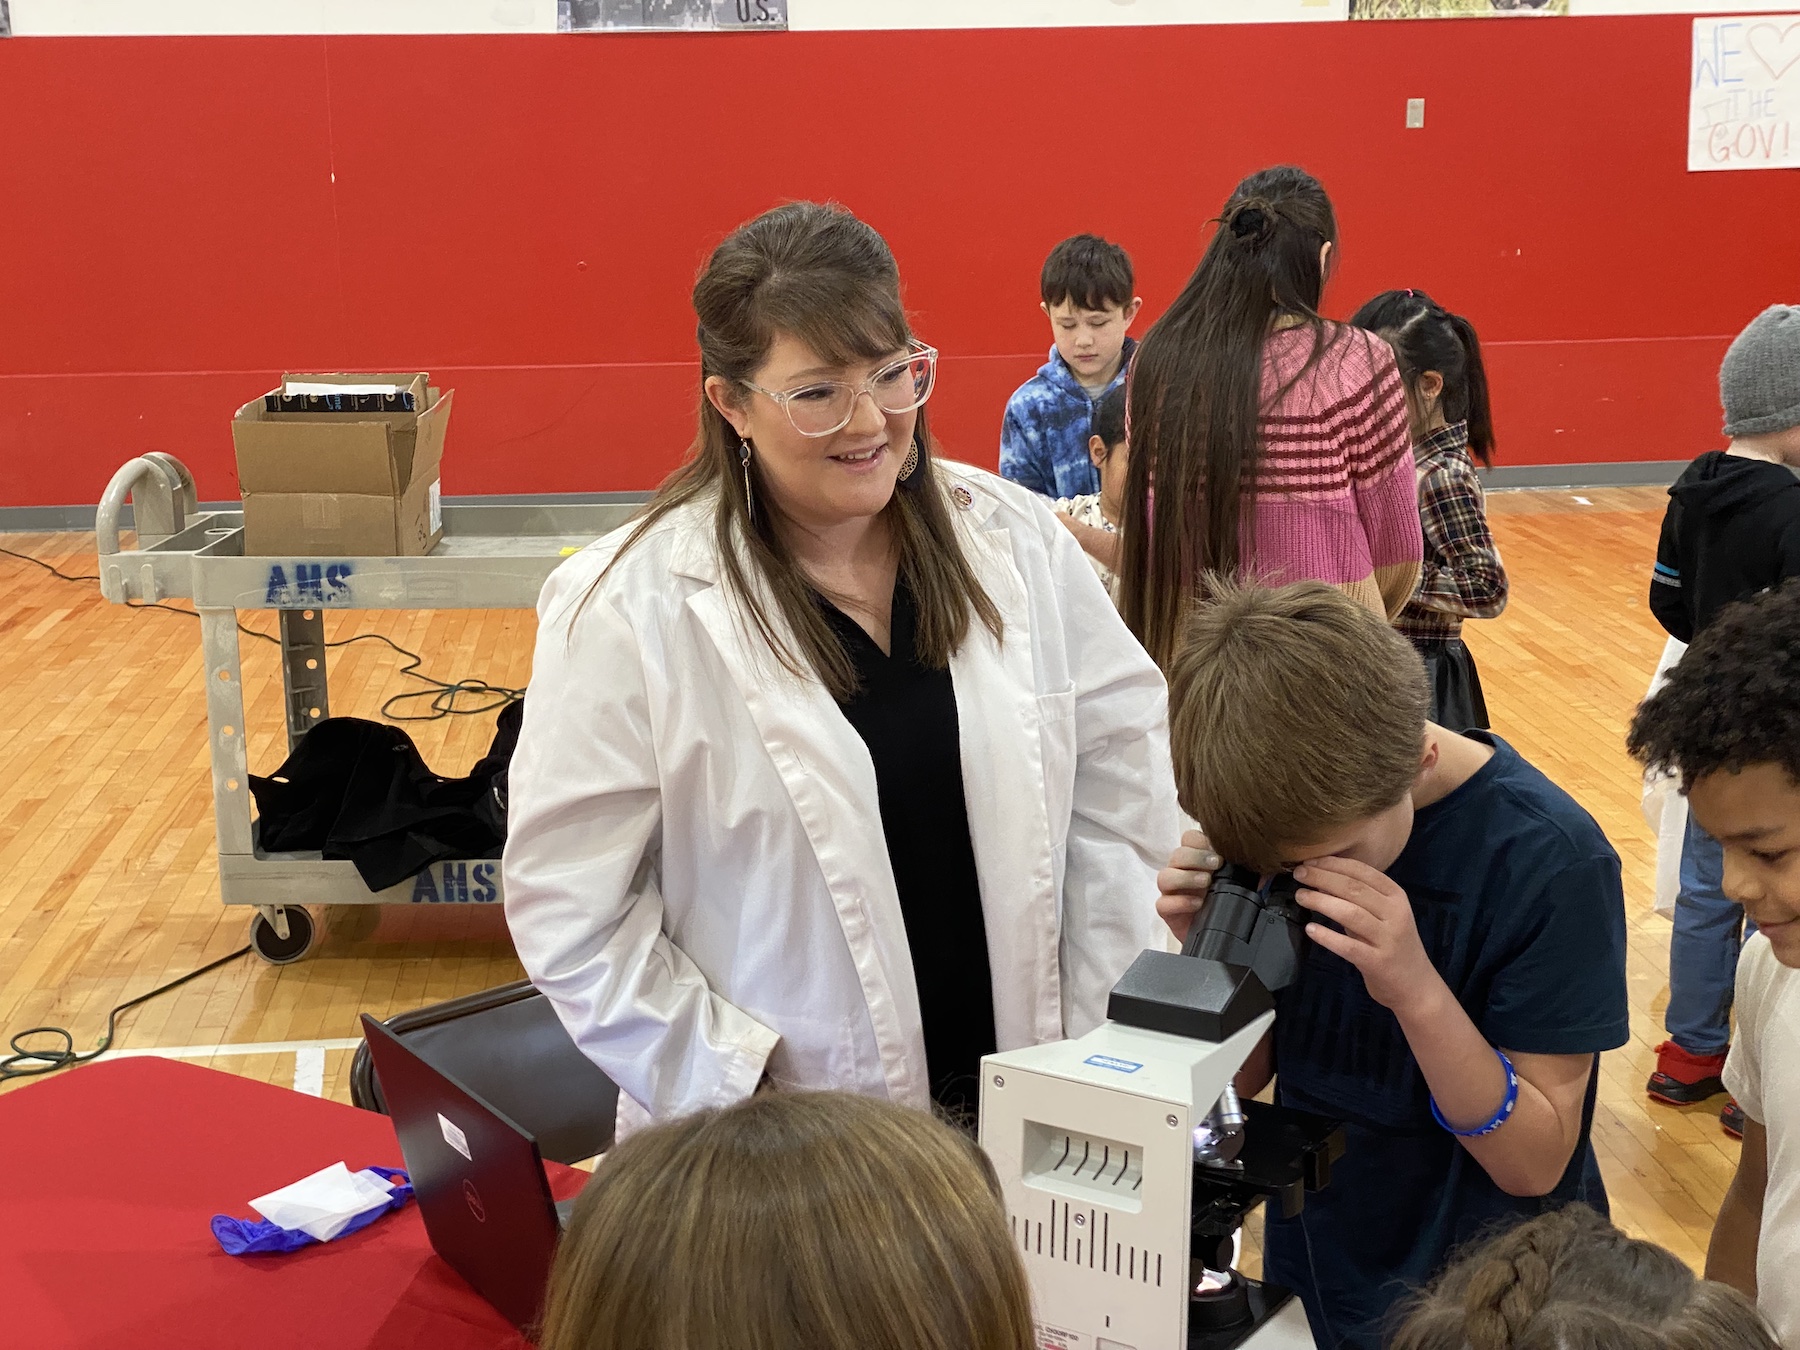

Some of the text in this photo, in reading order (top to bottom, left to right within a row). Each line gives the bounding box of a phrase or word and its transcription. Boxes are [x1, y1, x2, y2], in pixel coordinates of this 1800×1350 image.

[736, 0, 775, 23] U.S.
[1694, 23, 1743, 87] WE
[1727, 88, 1777, 118] THE
[1708, 121, 1790, 163] GOV!
[266, 564, 352, 604] AHS
[412, 862, 498, 903] AHS
